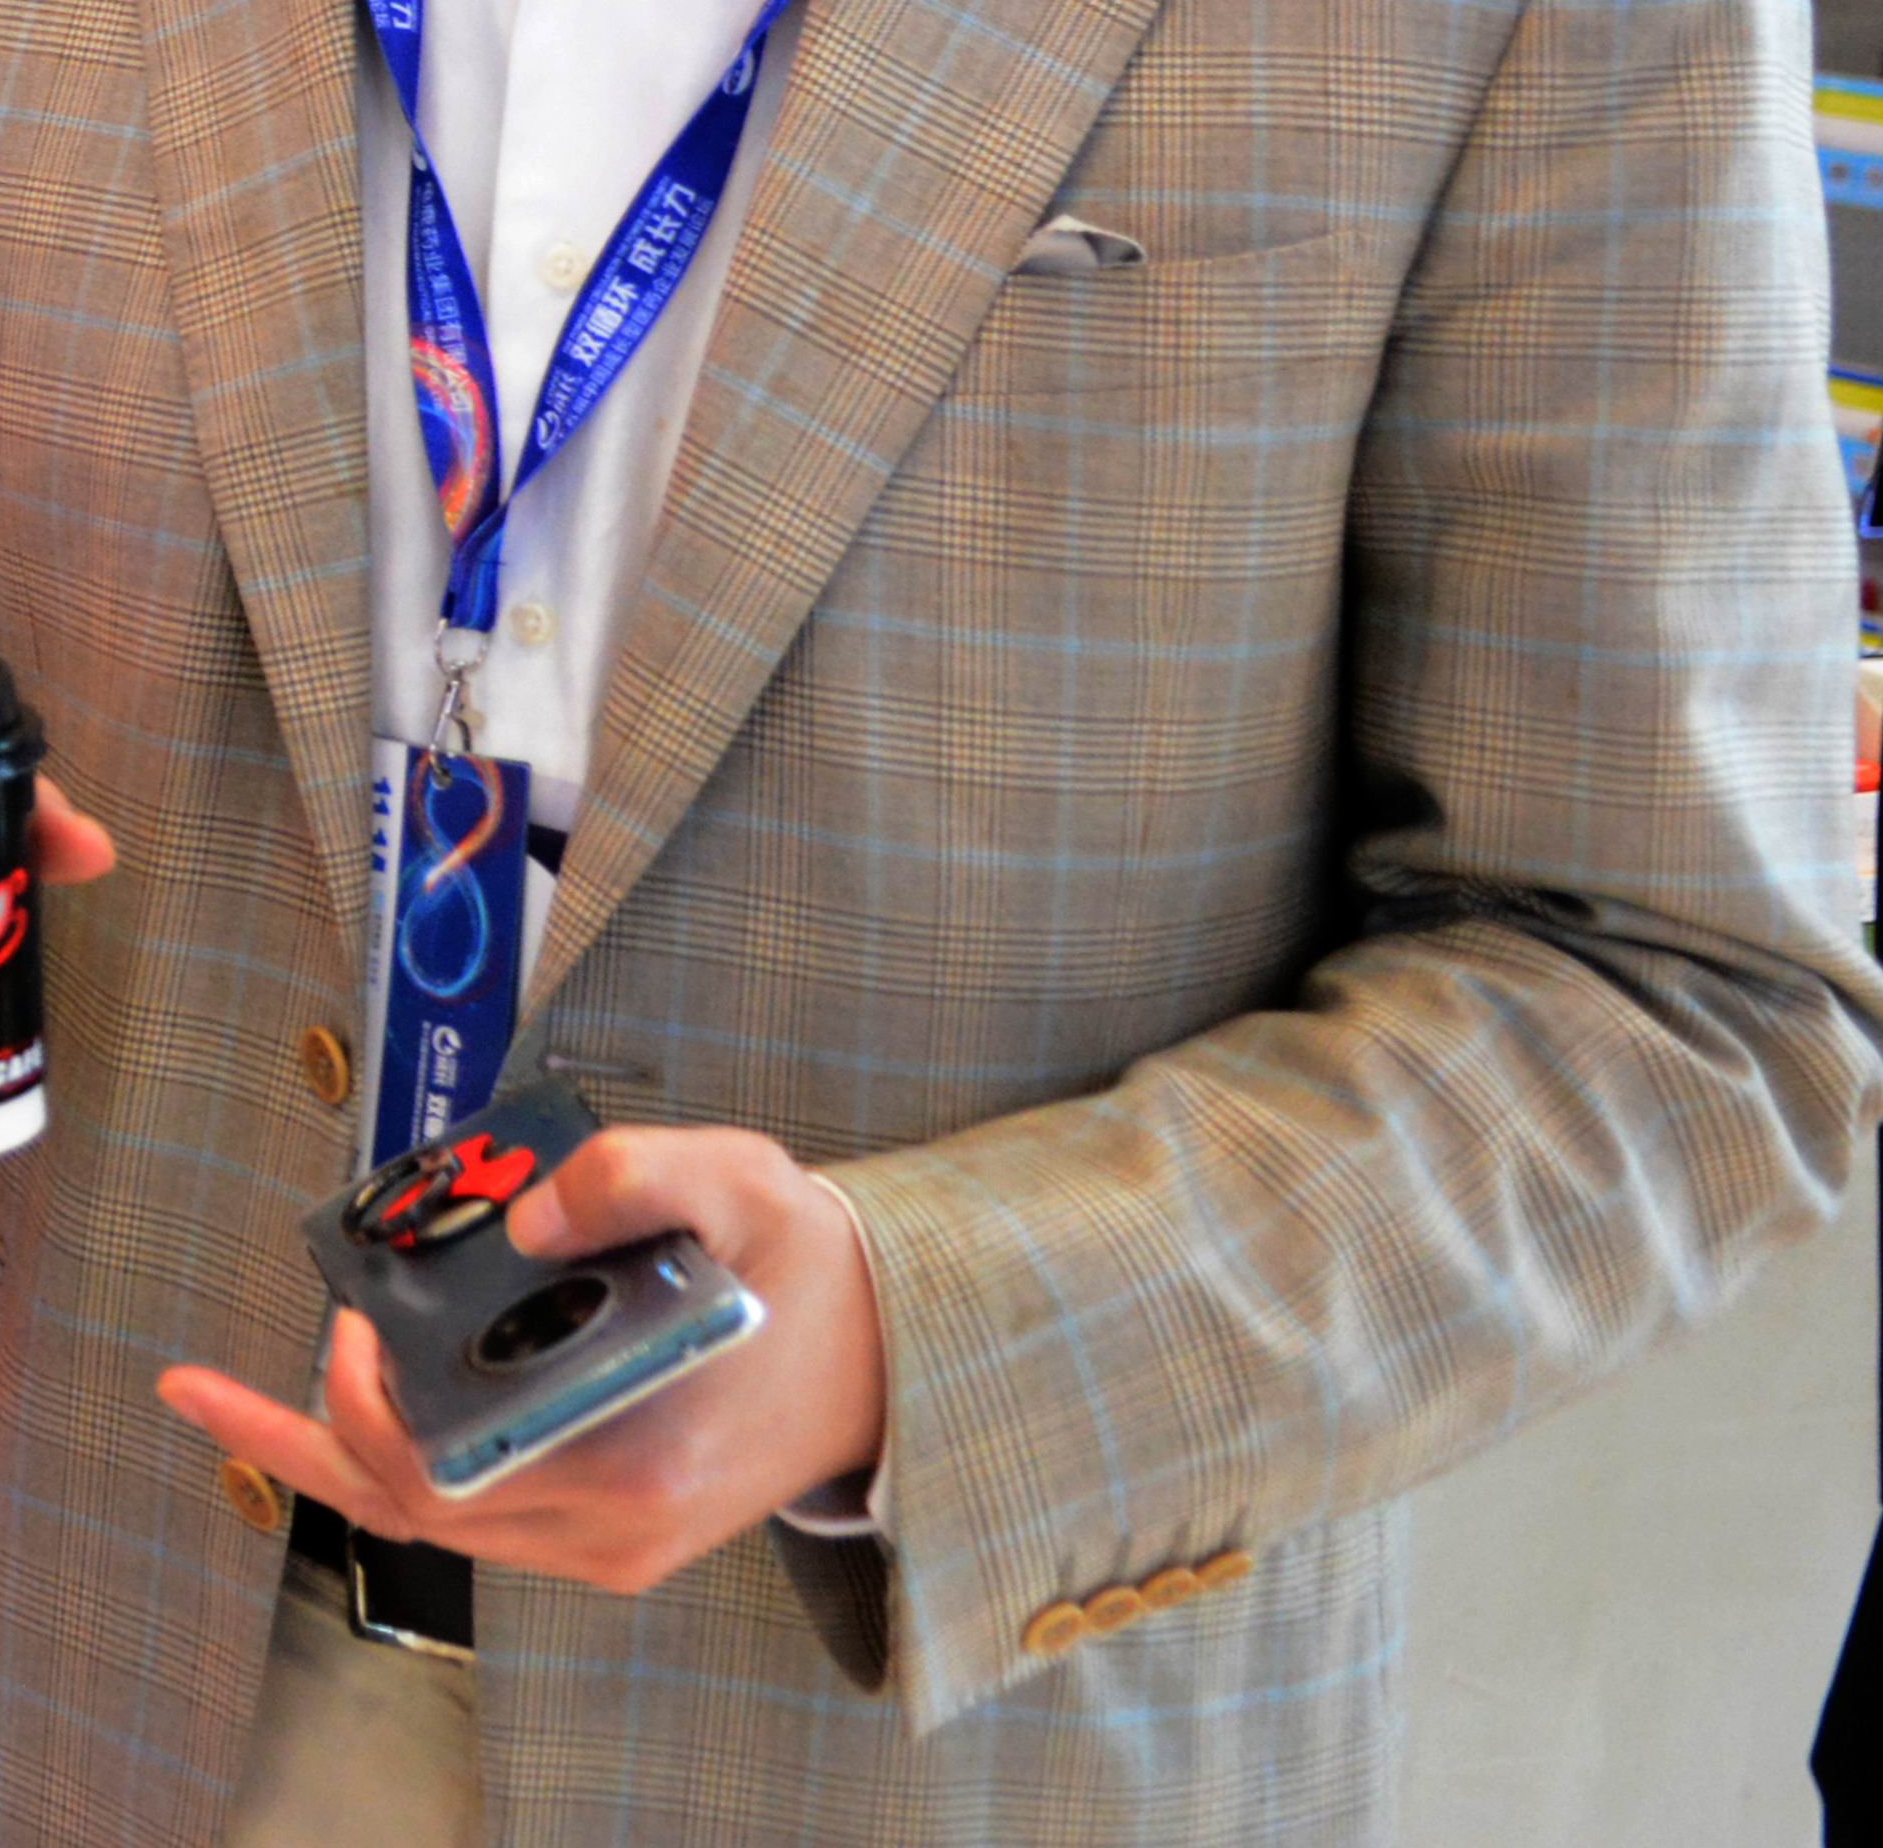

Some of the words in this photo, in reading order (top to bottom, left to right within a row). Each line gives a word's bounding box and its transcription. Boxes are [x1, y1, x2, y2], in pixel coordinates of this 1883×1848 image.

[566, 273, 642, 369] 双循环
[624, 179, 699, 276] 成长力
